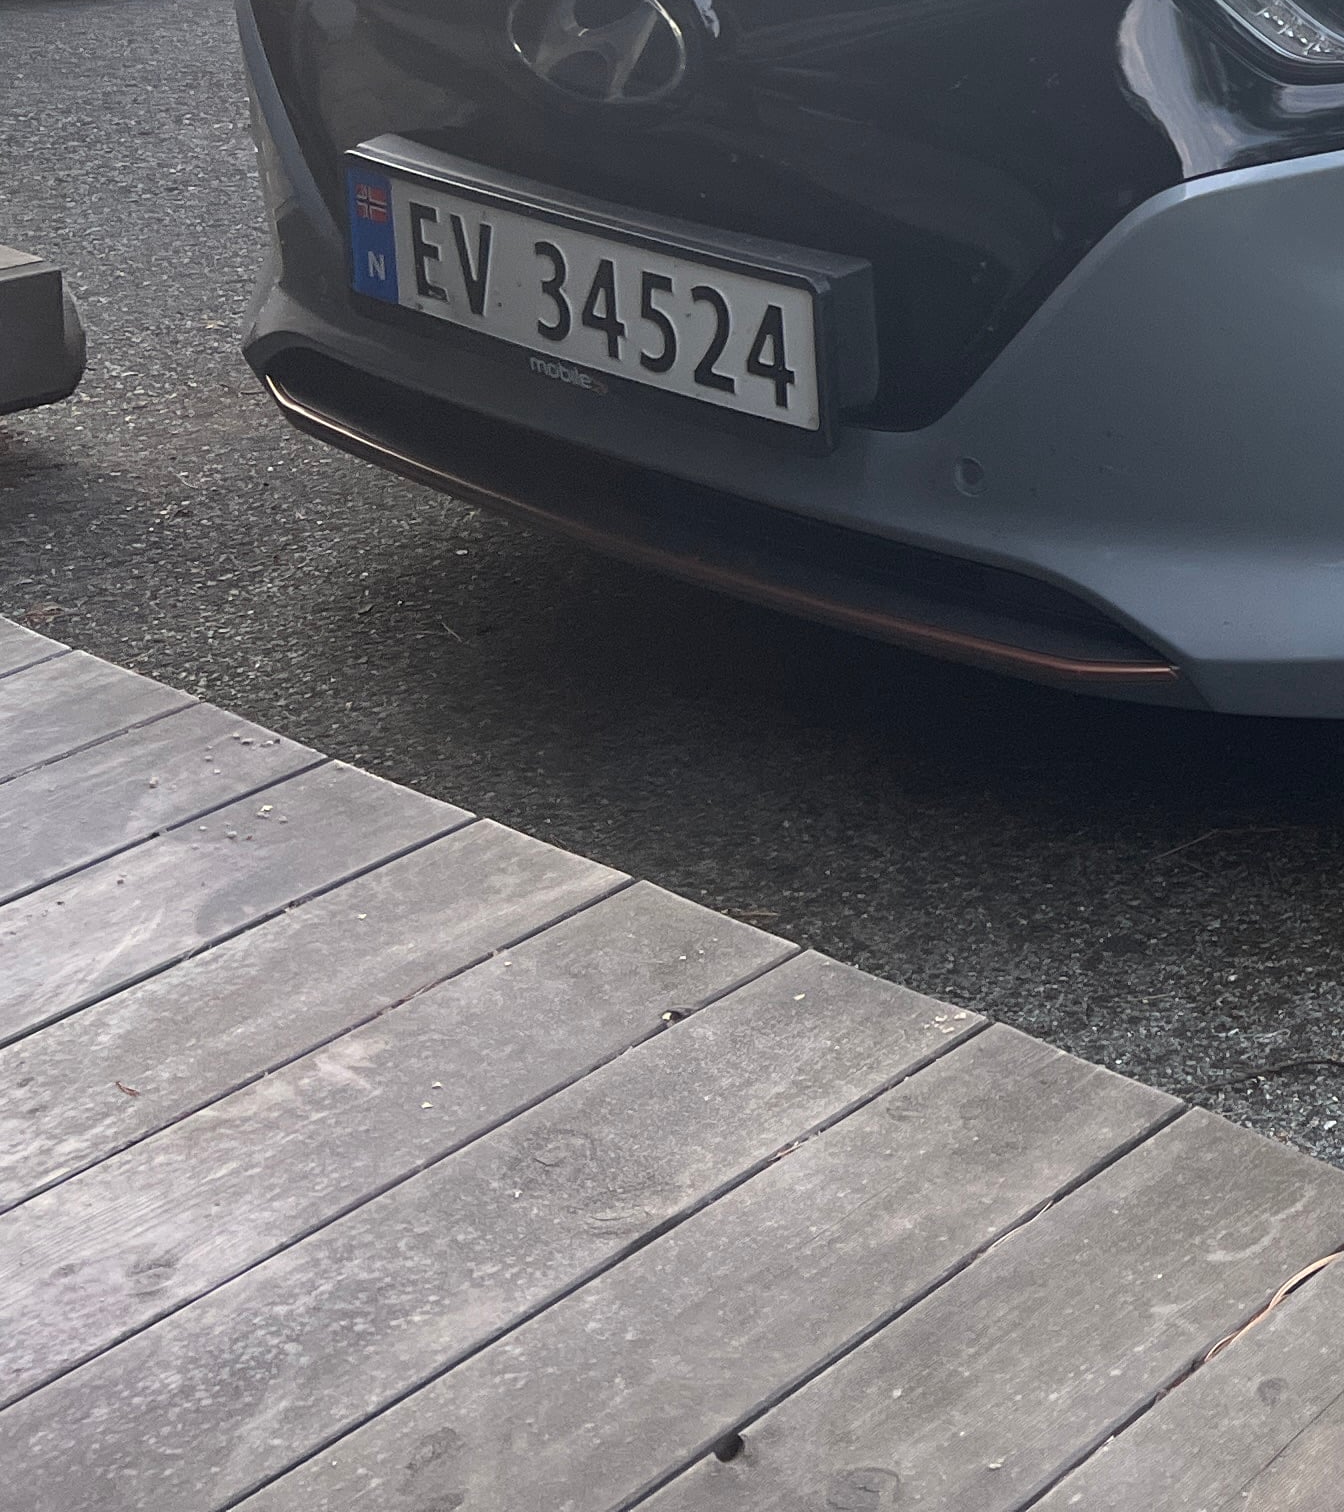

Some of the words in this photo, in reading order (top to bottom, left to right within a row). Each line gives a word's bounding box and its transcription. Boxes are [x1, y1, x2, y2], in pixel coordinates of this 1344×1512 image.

[369, 250, 386, 282] N
[409, 201, 492, 317] EV
[533, 240, 796, 408] 34524
